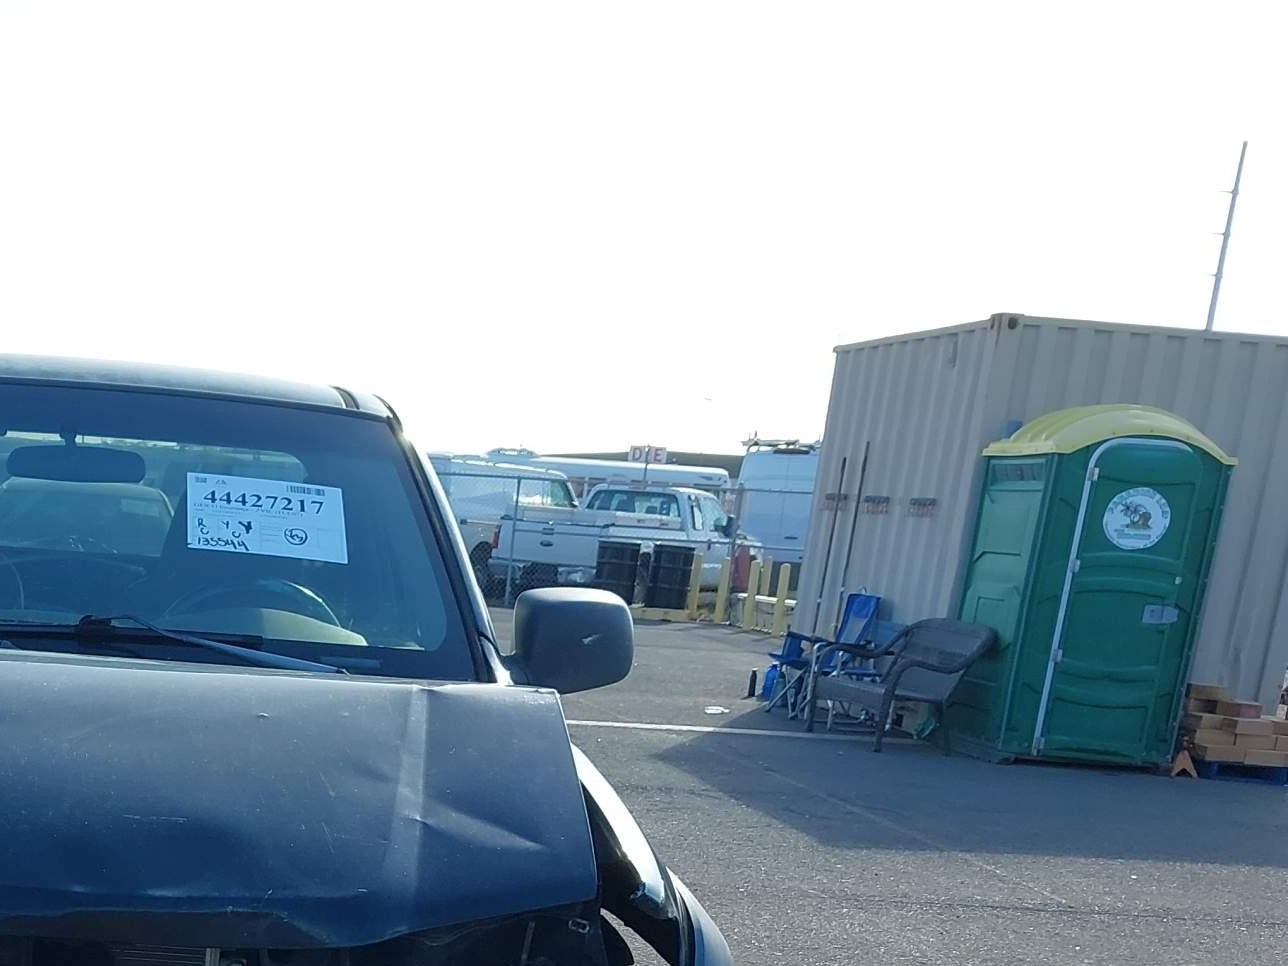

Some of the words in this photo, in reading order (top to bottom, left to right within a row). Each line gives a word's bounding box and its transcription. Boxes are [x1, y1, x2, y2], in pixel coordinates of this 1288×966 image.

[632, 447, 642, 461] D
[654, 448, 664, 462] E
[203, 489, 325, 515] 44427217
